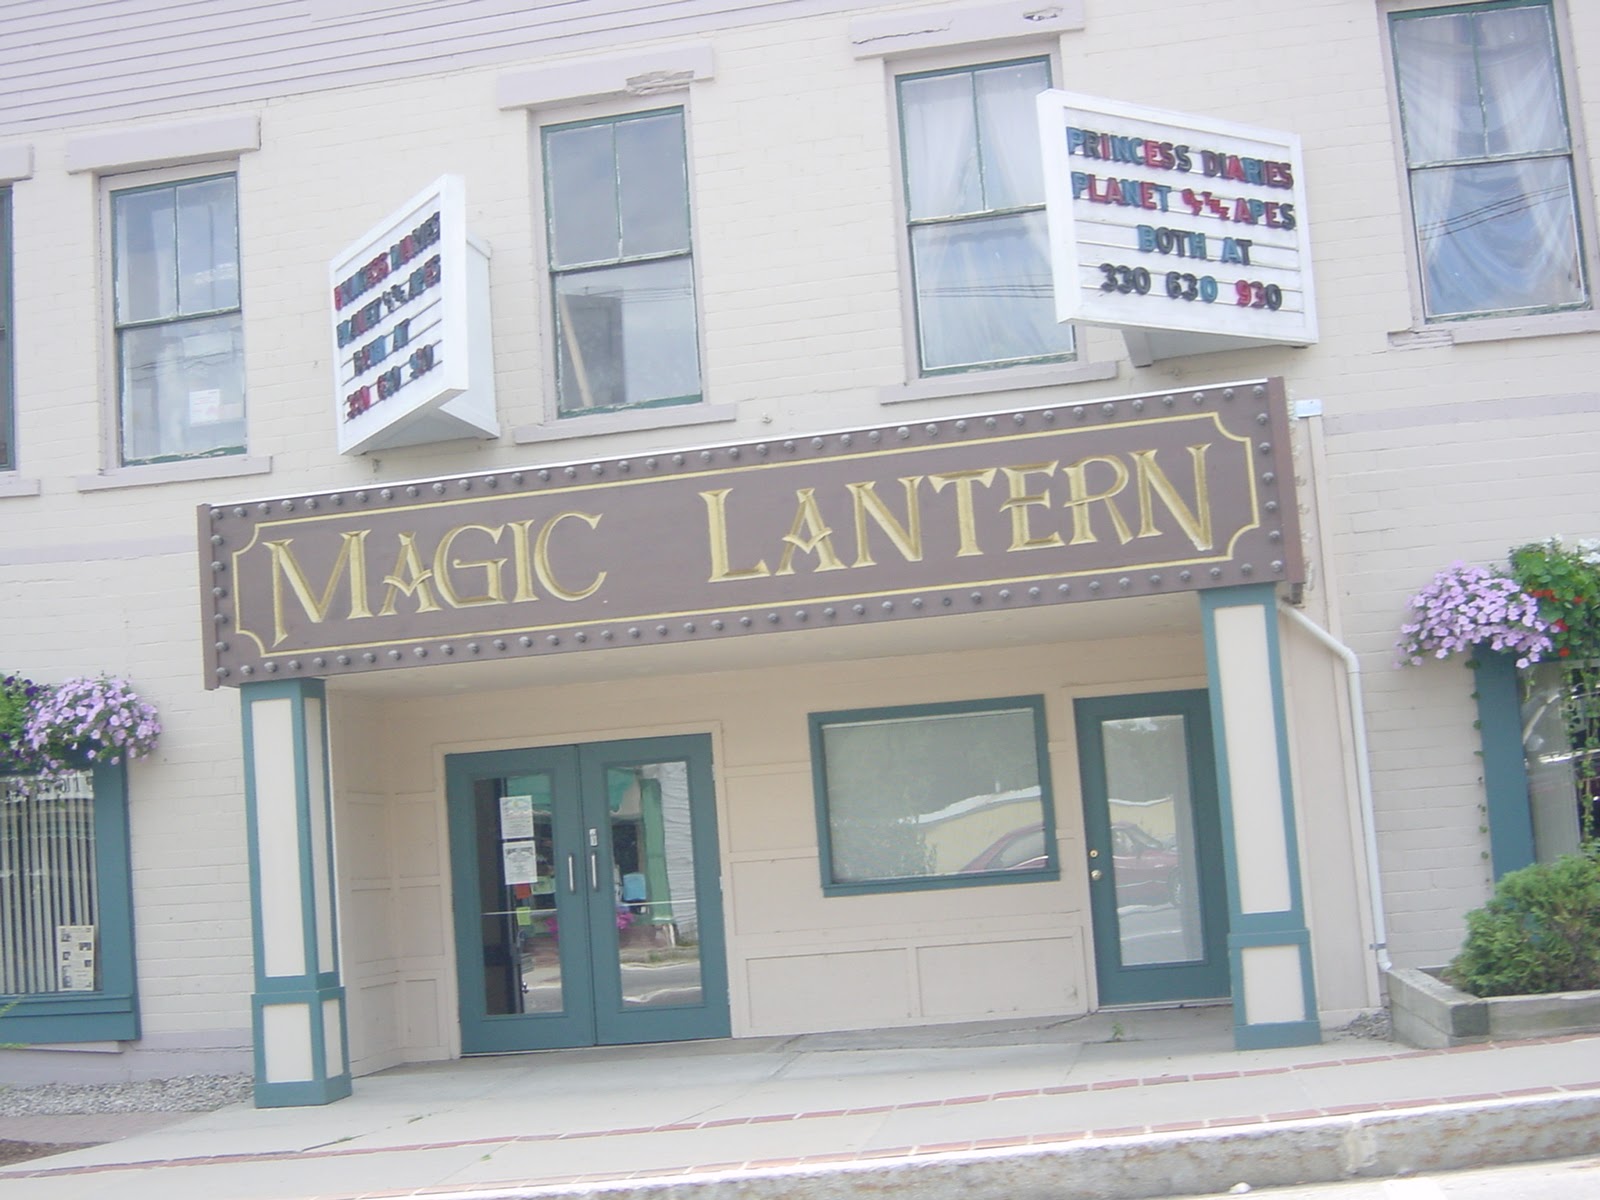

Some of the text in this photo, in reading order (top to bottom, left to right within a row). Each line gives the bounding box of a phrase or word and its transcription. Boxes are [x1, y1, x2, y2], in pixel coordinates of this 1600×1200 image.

[1066, 126, 1294, 190] PRINCESS DIARIES
[1071, 171, 1171, 212] PLANET
[1234, 197, 1296, 230] APES
[1137, 224, 1252, 266] BOTH AT
[1100, 263, 1282, 311] 330 630 930
[263, 443, 1211, 647] MAGIC LANTERN
